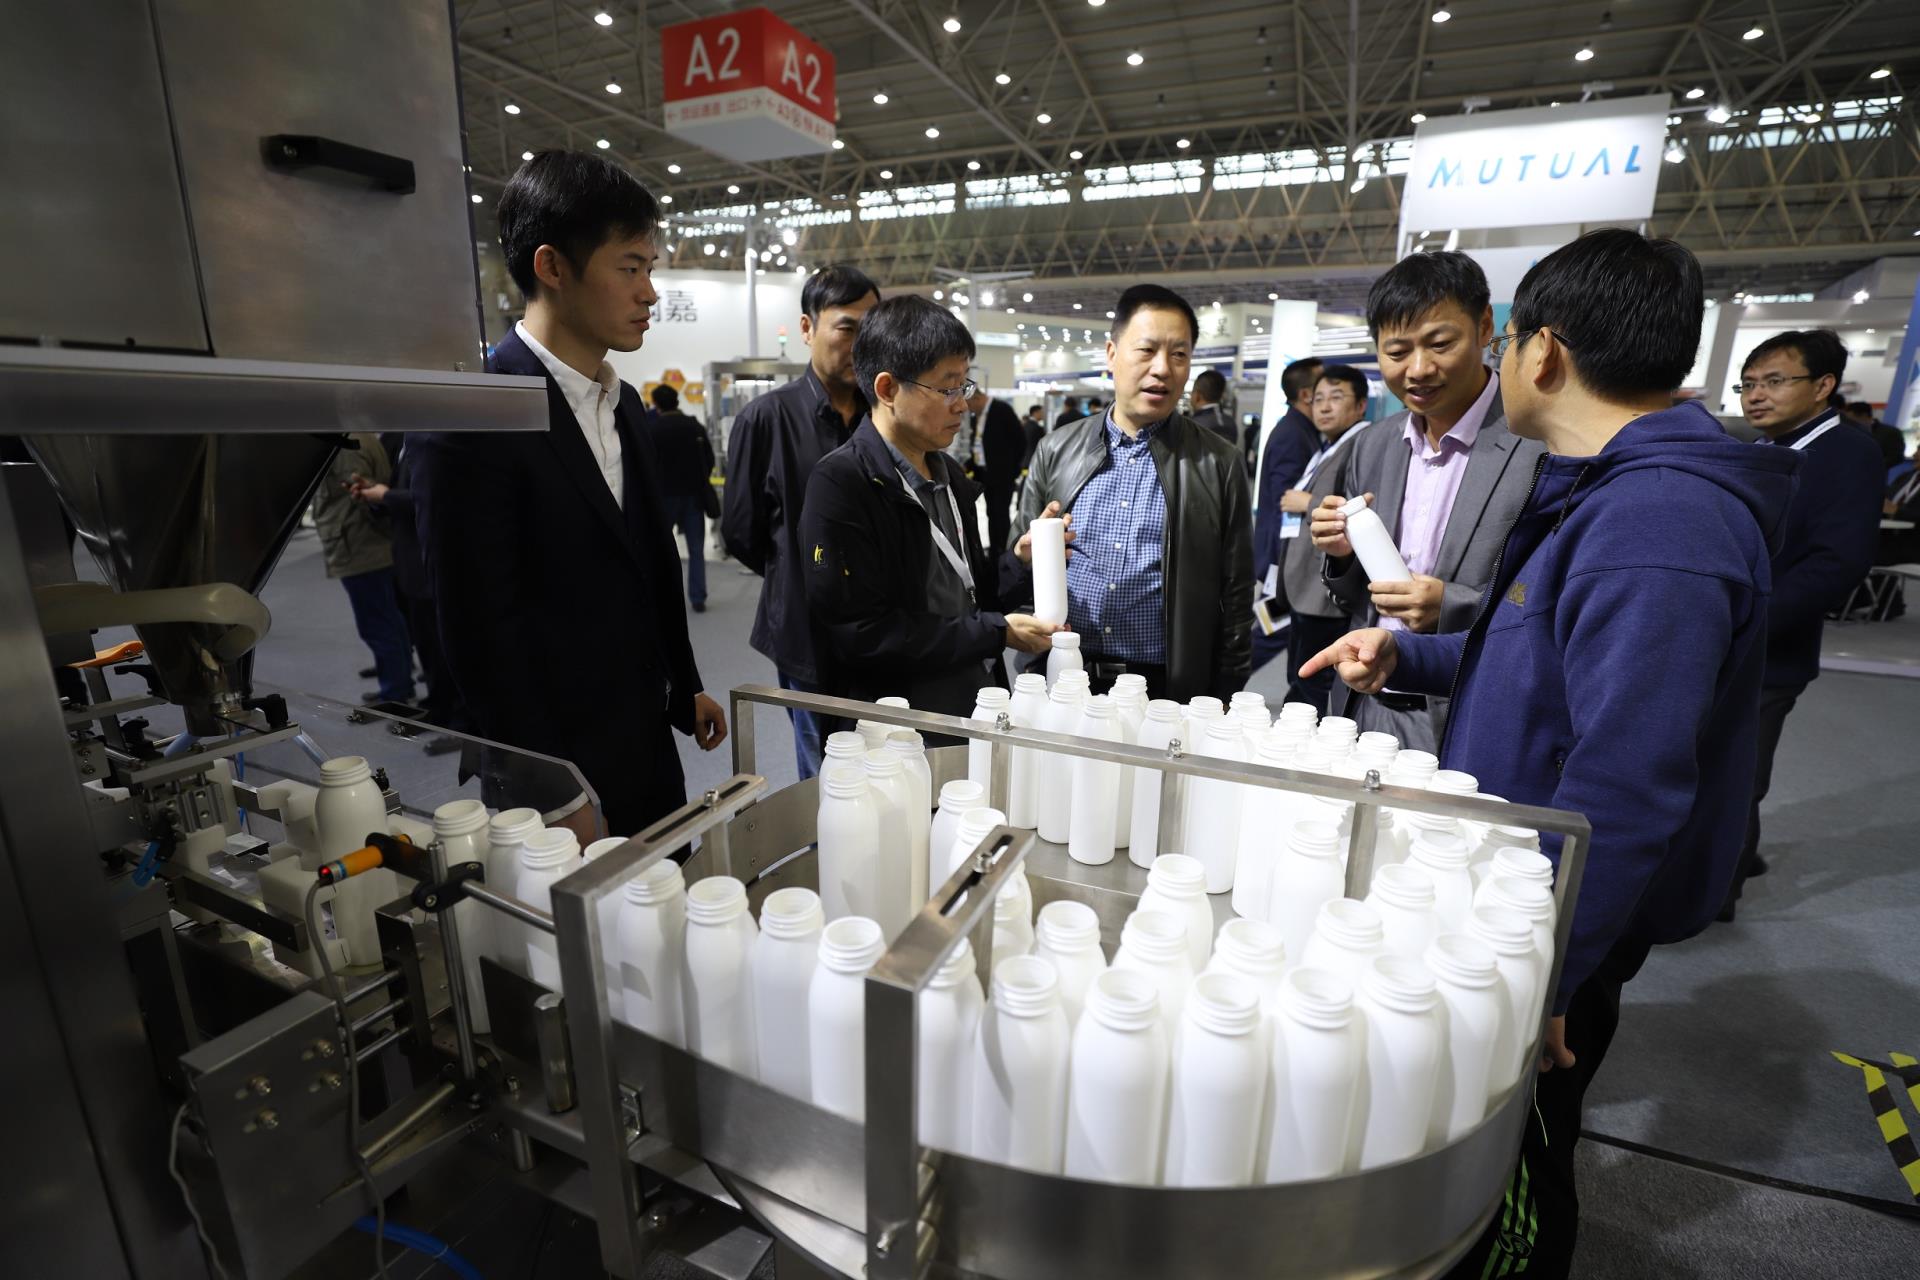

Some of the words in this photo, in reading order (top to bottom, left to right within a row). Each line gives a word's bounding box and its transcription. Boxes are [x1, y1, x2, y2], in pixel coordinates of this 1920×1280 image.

[684, 27, 741, 87] A2
[781, 40, 821, 105] A2
[1428, 144, 1641, 189] MUTUAL
